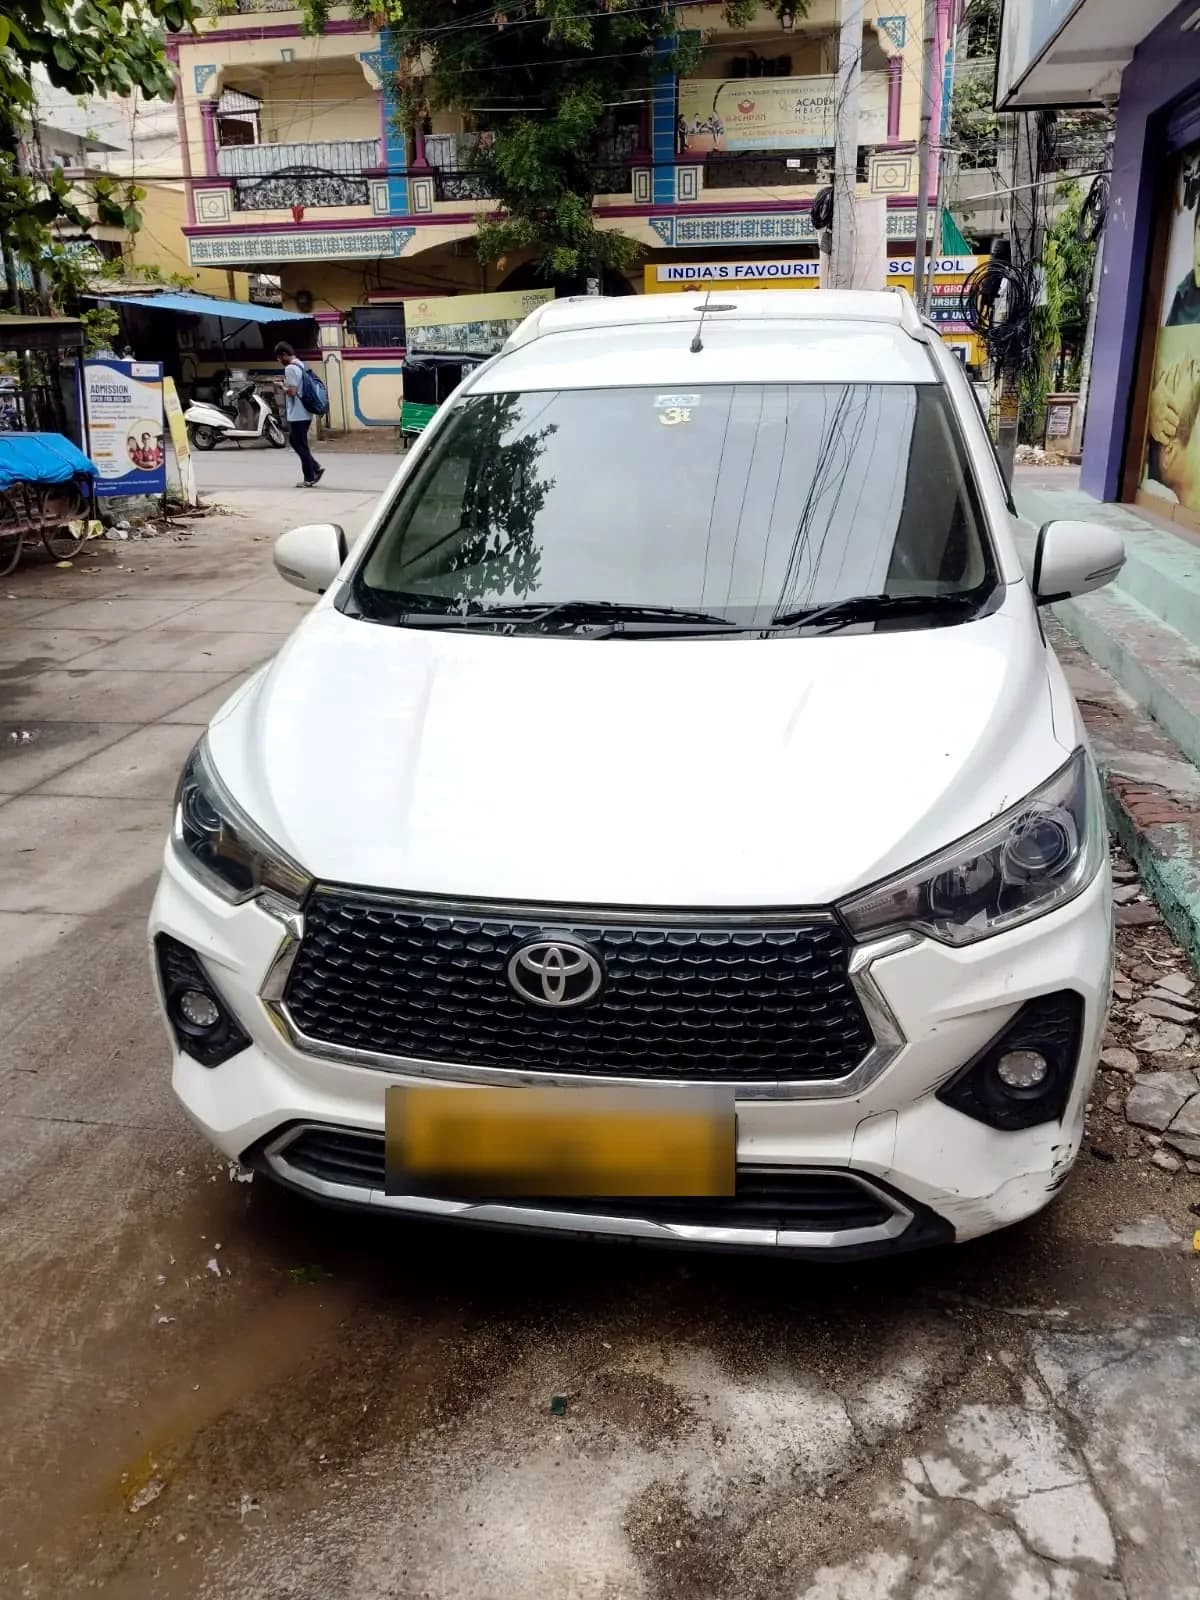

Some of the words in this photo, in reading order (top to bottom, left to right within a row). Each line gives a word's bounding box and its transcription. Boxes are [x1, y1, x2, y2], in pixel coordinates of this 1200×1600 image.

[668, 266, 729, 279] INDIA'S
[735, 263, 820, 277] FAVOURIT
[889, 260, 965, 273] SCOOL
[90, 384, 129, 394] ADMISSION
